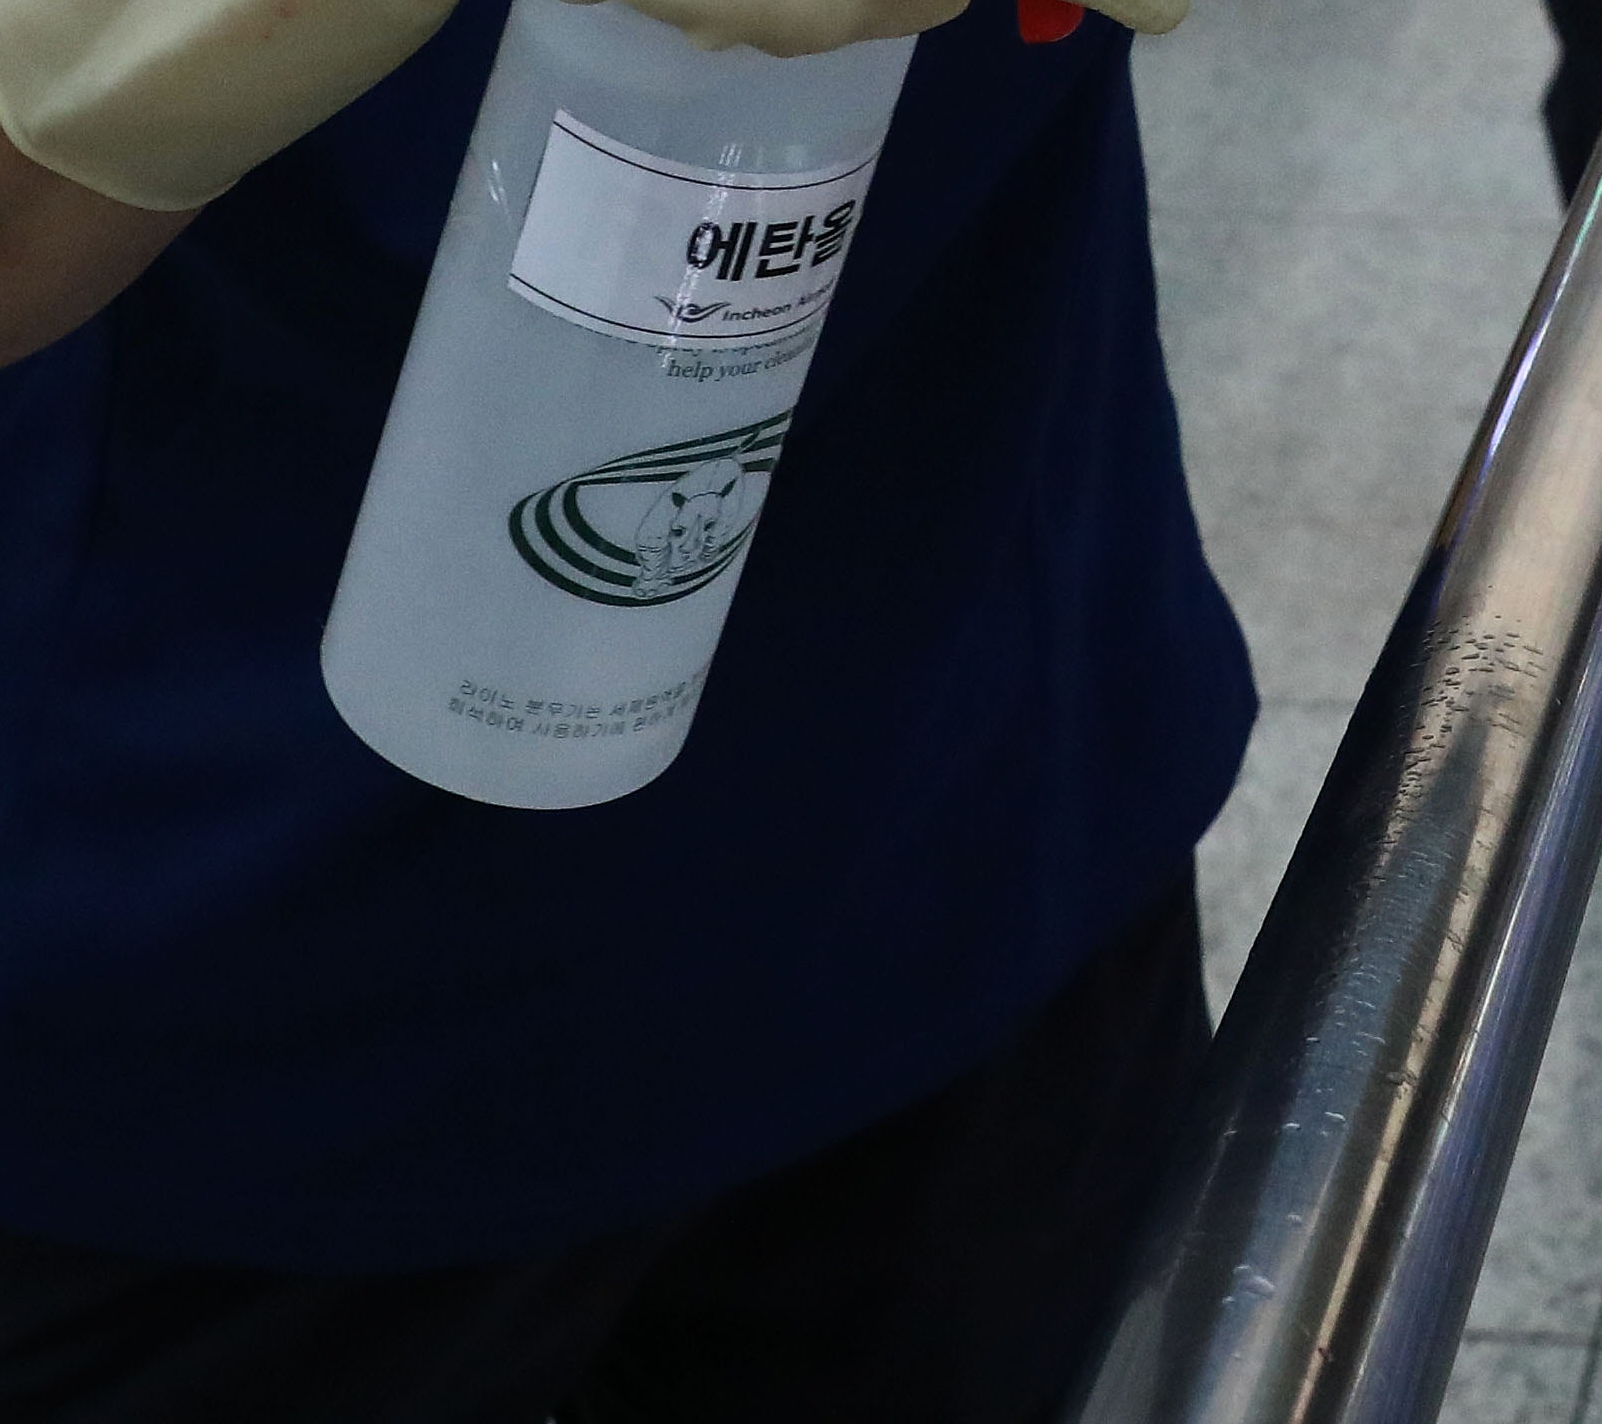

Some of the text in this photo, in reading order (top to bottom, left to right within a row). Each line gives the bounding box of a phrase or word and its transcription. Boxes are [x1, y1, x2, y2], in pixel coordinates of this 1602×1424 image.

[721, 302, 792, 322] Incheon
[666, 359, 713, 382] help
[714, 359, 762, 382] your
